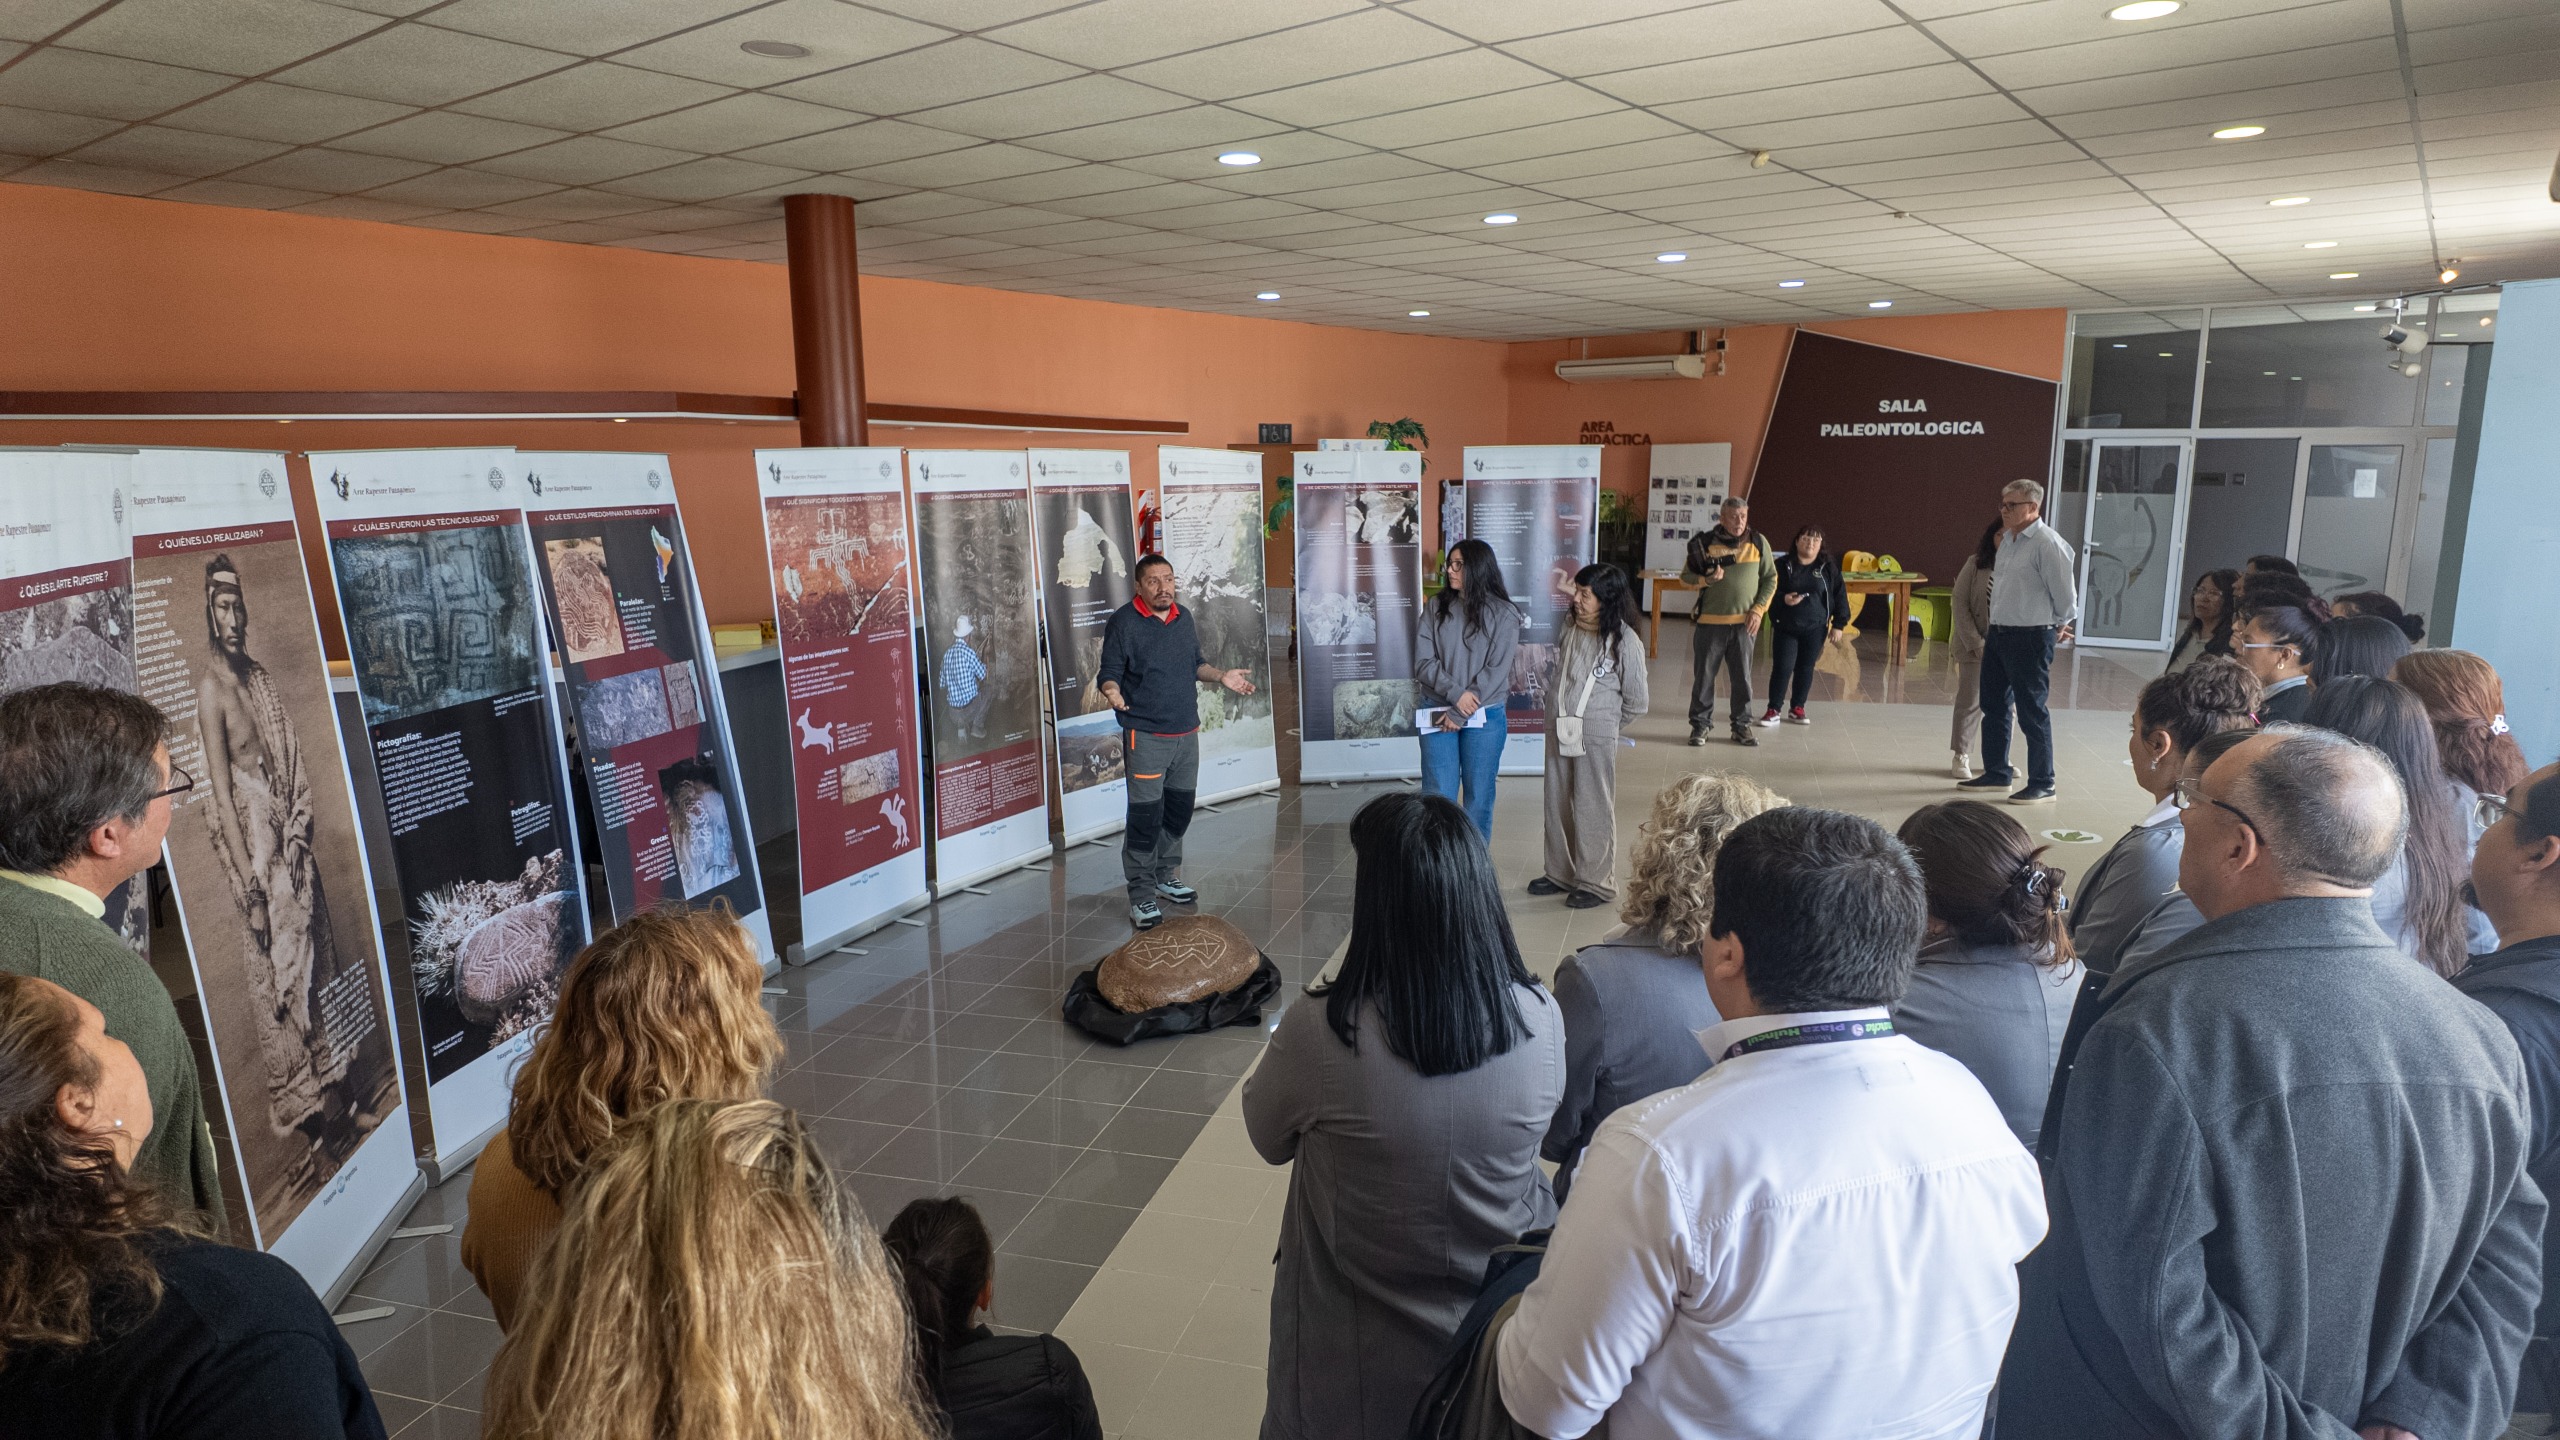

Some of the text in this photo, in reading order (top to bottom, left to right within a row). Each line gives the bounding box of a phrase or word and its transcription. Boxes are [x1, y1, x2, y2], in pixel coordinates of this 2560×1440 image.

[1878, 399, 1927, 413] SALA
[1581, 421, 1614, 433] AREA
[1821, 421, 1985, 437] PALEONTOLOGICA
[1580, 433, 1652, 445] DIDACTICA
[365, 487, 388, 497] Rupestre
[799, 497, 829, 505] SIGNIFICAN
[563, 512, 587, 520] ESTILOS
[587, 510, 624, 519] PREDOMINAN
[359, 521, 390, 532] CUÁLES
[391, 520, 421, 529] FUERON
[421, 518, 436, 527] LAS
[436, 515, 470, 526] TÉCNICAS
[470, 515, 496, 523] USADAS
[158, 529, 264, 549] ¿ QUIÉNES LO REALIZABAN ?
[20, 586, 25, 598] ¿
[41, 584, 50, 593] ES
[56, 578, 72, 589] ARTE
[72, 572, 104, 587] RUPESTRE
[104, 571, 109, 580] ?
[1747, 1022, 1845, 1047] Plaza Huincul
